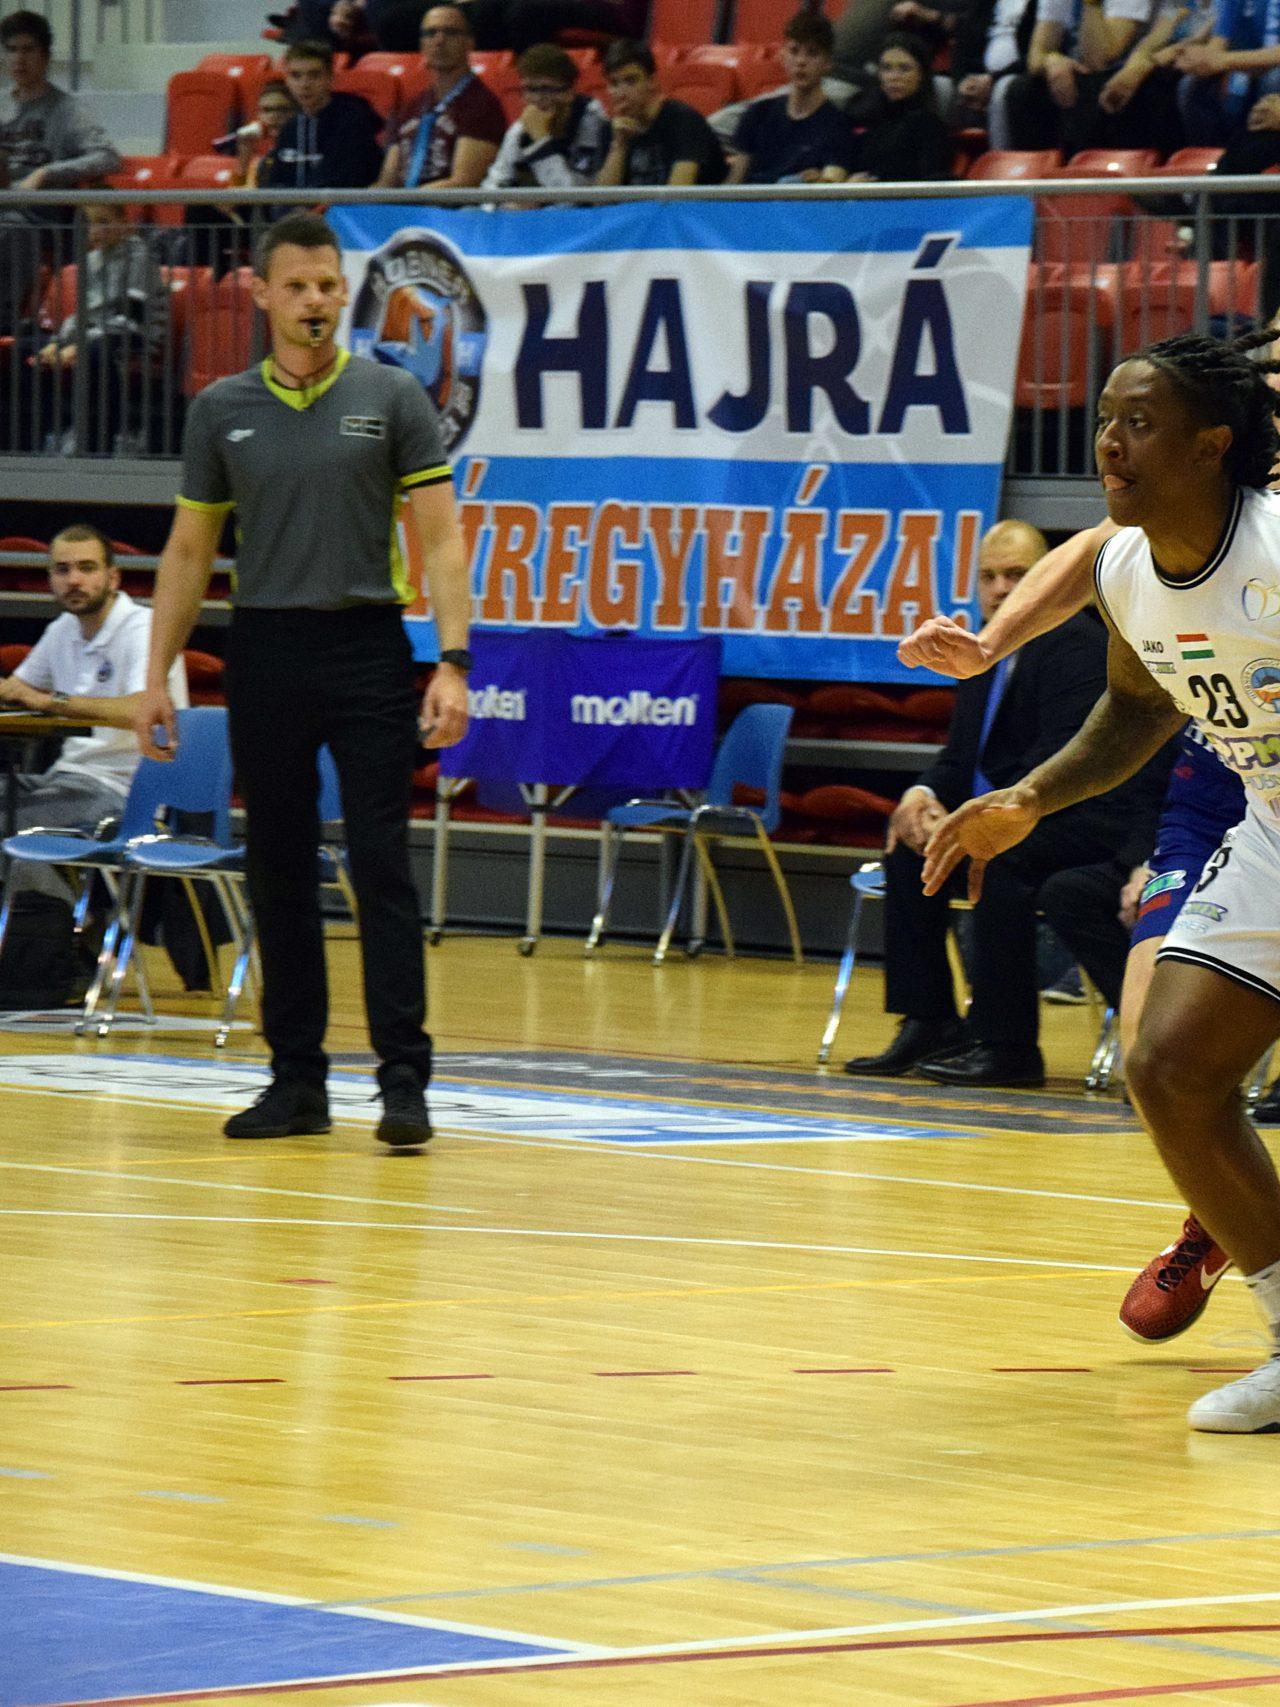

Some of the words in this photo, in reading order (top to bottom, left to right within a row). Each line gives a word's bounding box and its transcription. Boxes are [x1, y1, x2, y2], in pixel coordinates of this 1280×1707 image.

[515, 238, 970, 435] HAJRÁ
[400, 458, 983, 640] ÍREGYHÁZA!
[1142, 640, 1165, 654] JAKO
[571, 690, 696, 727] molten
[1188, 673, 1249, 728] 23
